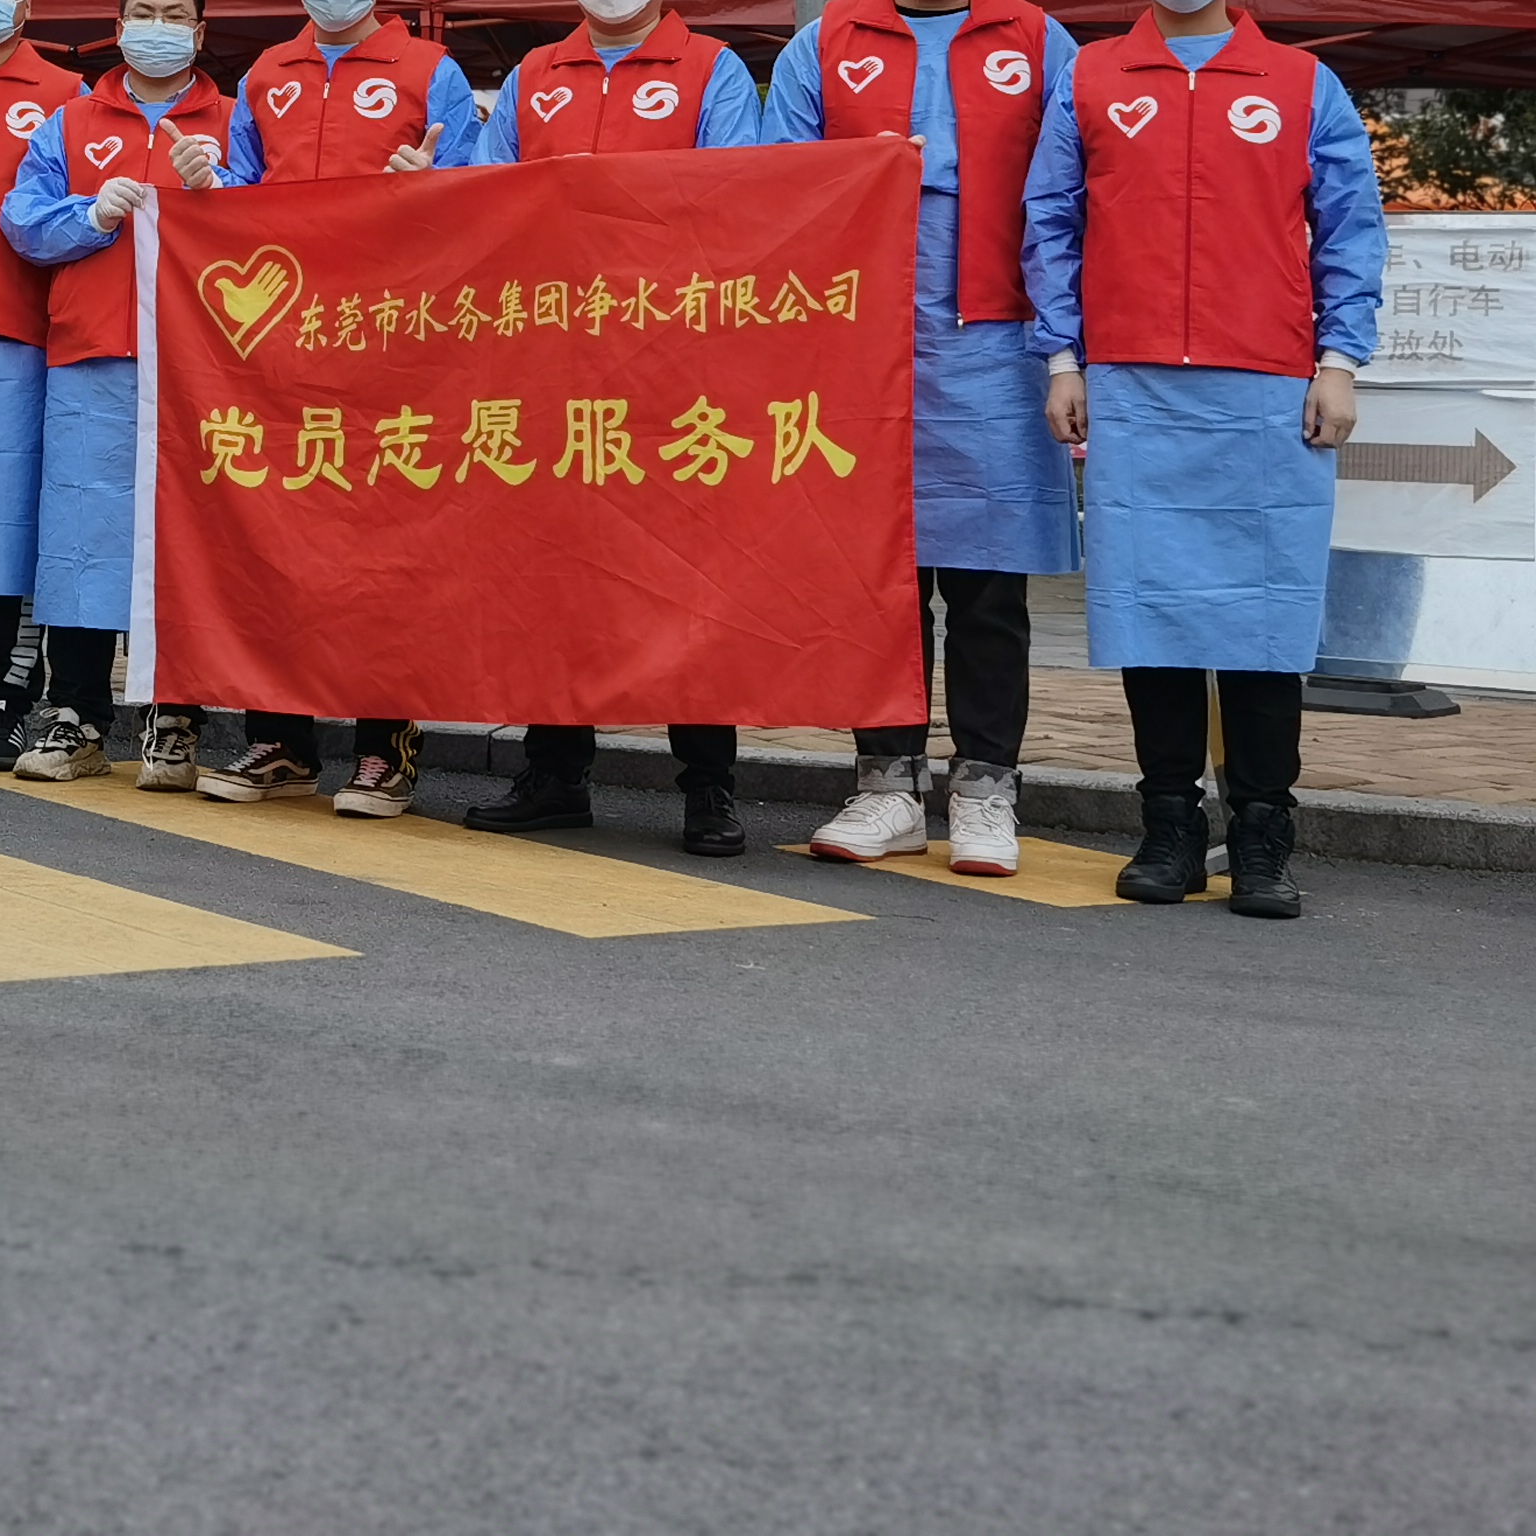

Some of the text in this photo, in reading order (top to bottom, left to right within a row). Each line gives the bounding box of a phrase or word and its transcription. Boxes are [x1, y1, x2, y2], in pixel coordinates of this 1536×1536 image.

[295, 269, 860, 353] 东莞市水务集团净水有限公司
[1392, 284, 1504, 317] 自行车
[1370, 329, 1464, 362] 放处
[200, 391, 856, 491] 党员志愿服务队
